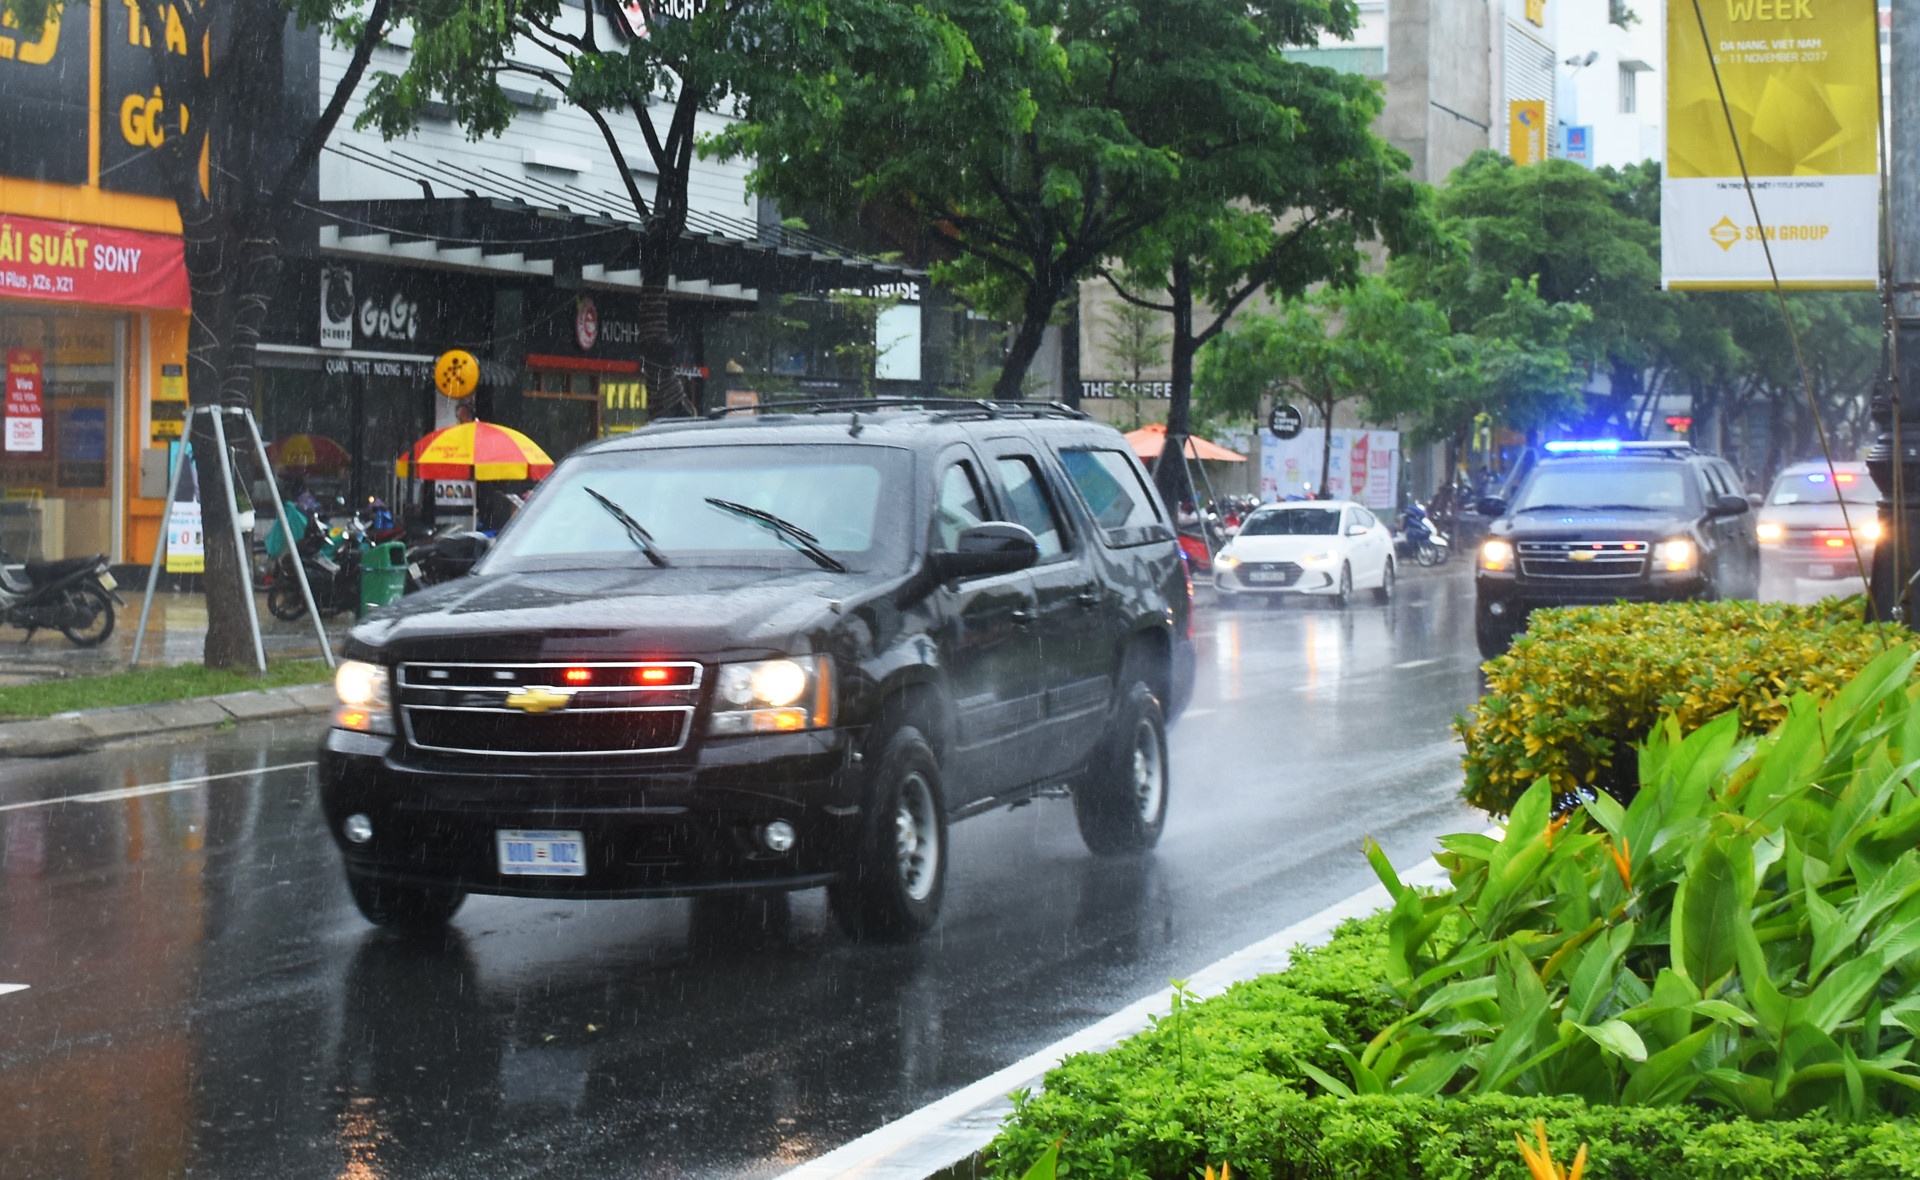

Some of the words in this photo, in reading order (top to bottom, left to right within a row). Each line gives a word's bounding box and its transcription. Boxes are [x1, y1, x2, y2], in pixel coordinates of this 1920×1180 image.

[1727, 0, 1814, 21] WEEK
[1797, 38, 1822, 48] NAM
[1730, 53, 1741, 63] 11
[1744, 52, 1799, 63] NOVEMBER
[1802, 51, 1828, 61] 2017
[1779, 225, 1829, 240] GROUP
[29, 227, 89, 268] SUẤT
[93, 244, 141, 273] SONY
[361, 294, 418, 339] GoGi
[1082, 382, 1115, 398] THE
